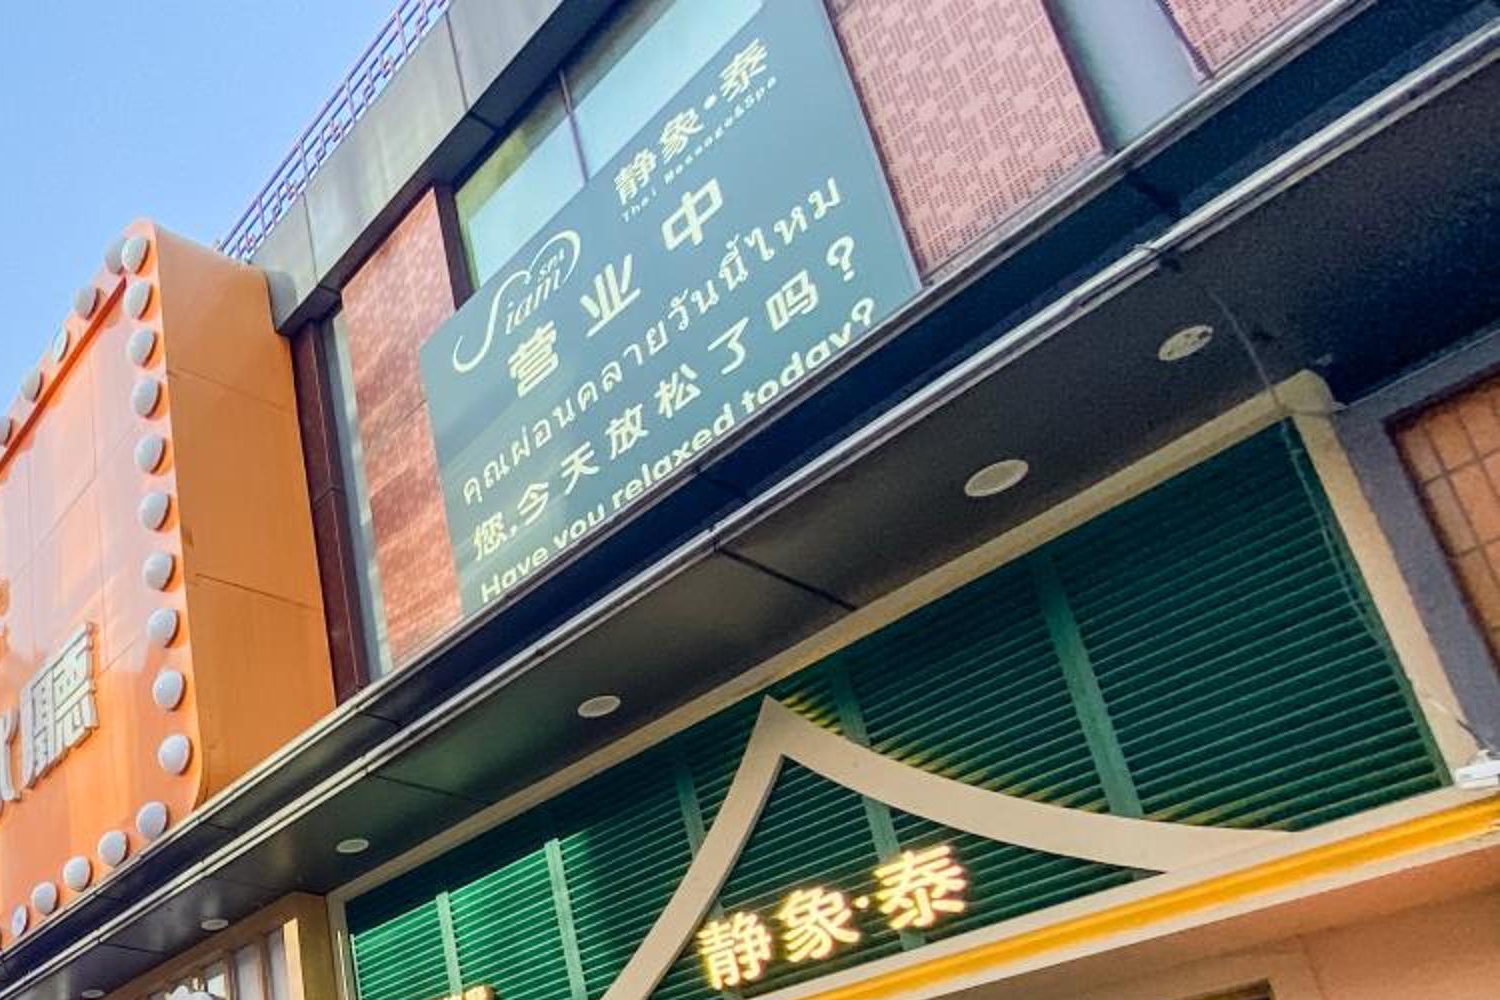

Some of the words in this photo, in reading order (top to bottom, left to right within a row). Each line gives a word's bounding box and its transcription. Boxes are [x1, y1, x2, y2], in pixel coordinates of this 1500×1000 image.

[614, 38, 768, 206] 静象·泰
[452, 229, 581, 373] Siam
[507, 178, 724, 397] 营业中
[481, 543, 550, 603] Have
[553, 507, 605, 547] you
[612, 406, 735, 509] relaxed
[741, 298, 876, 411] today?
[696, 845, 968, 991] 静象·泰
